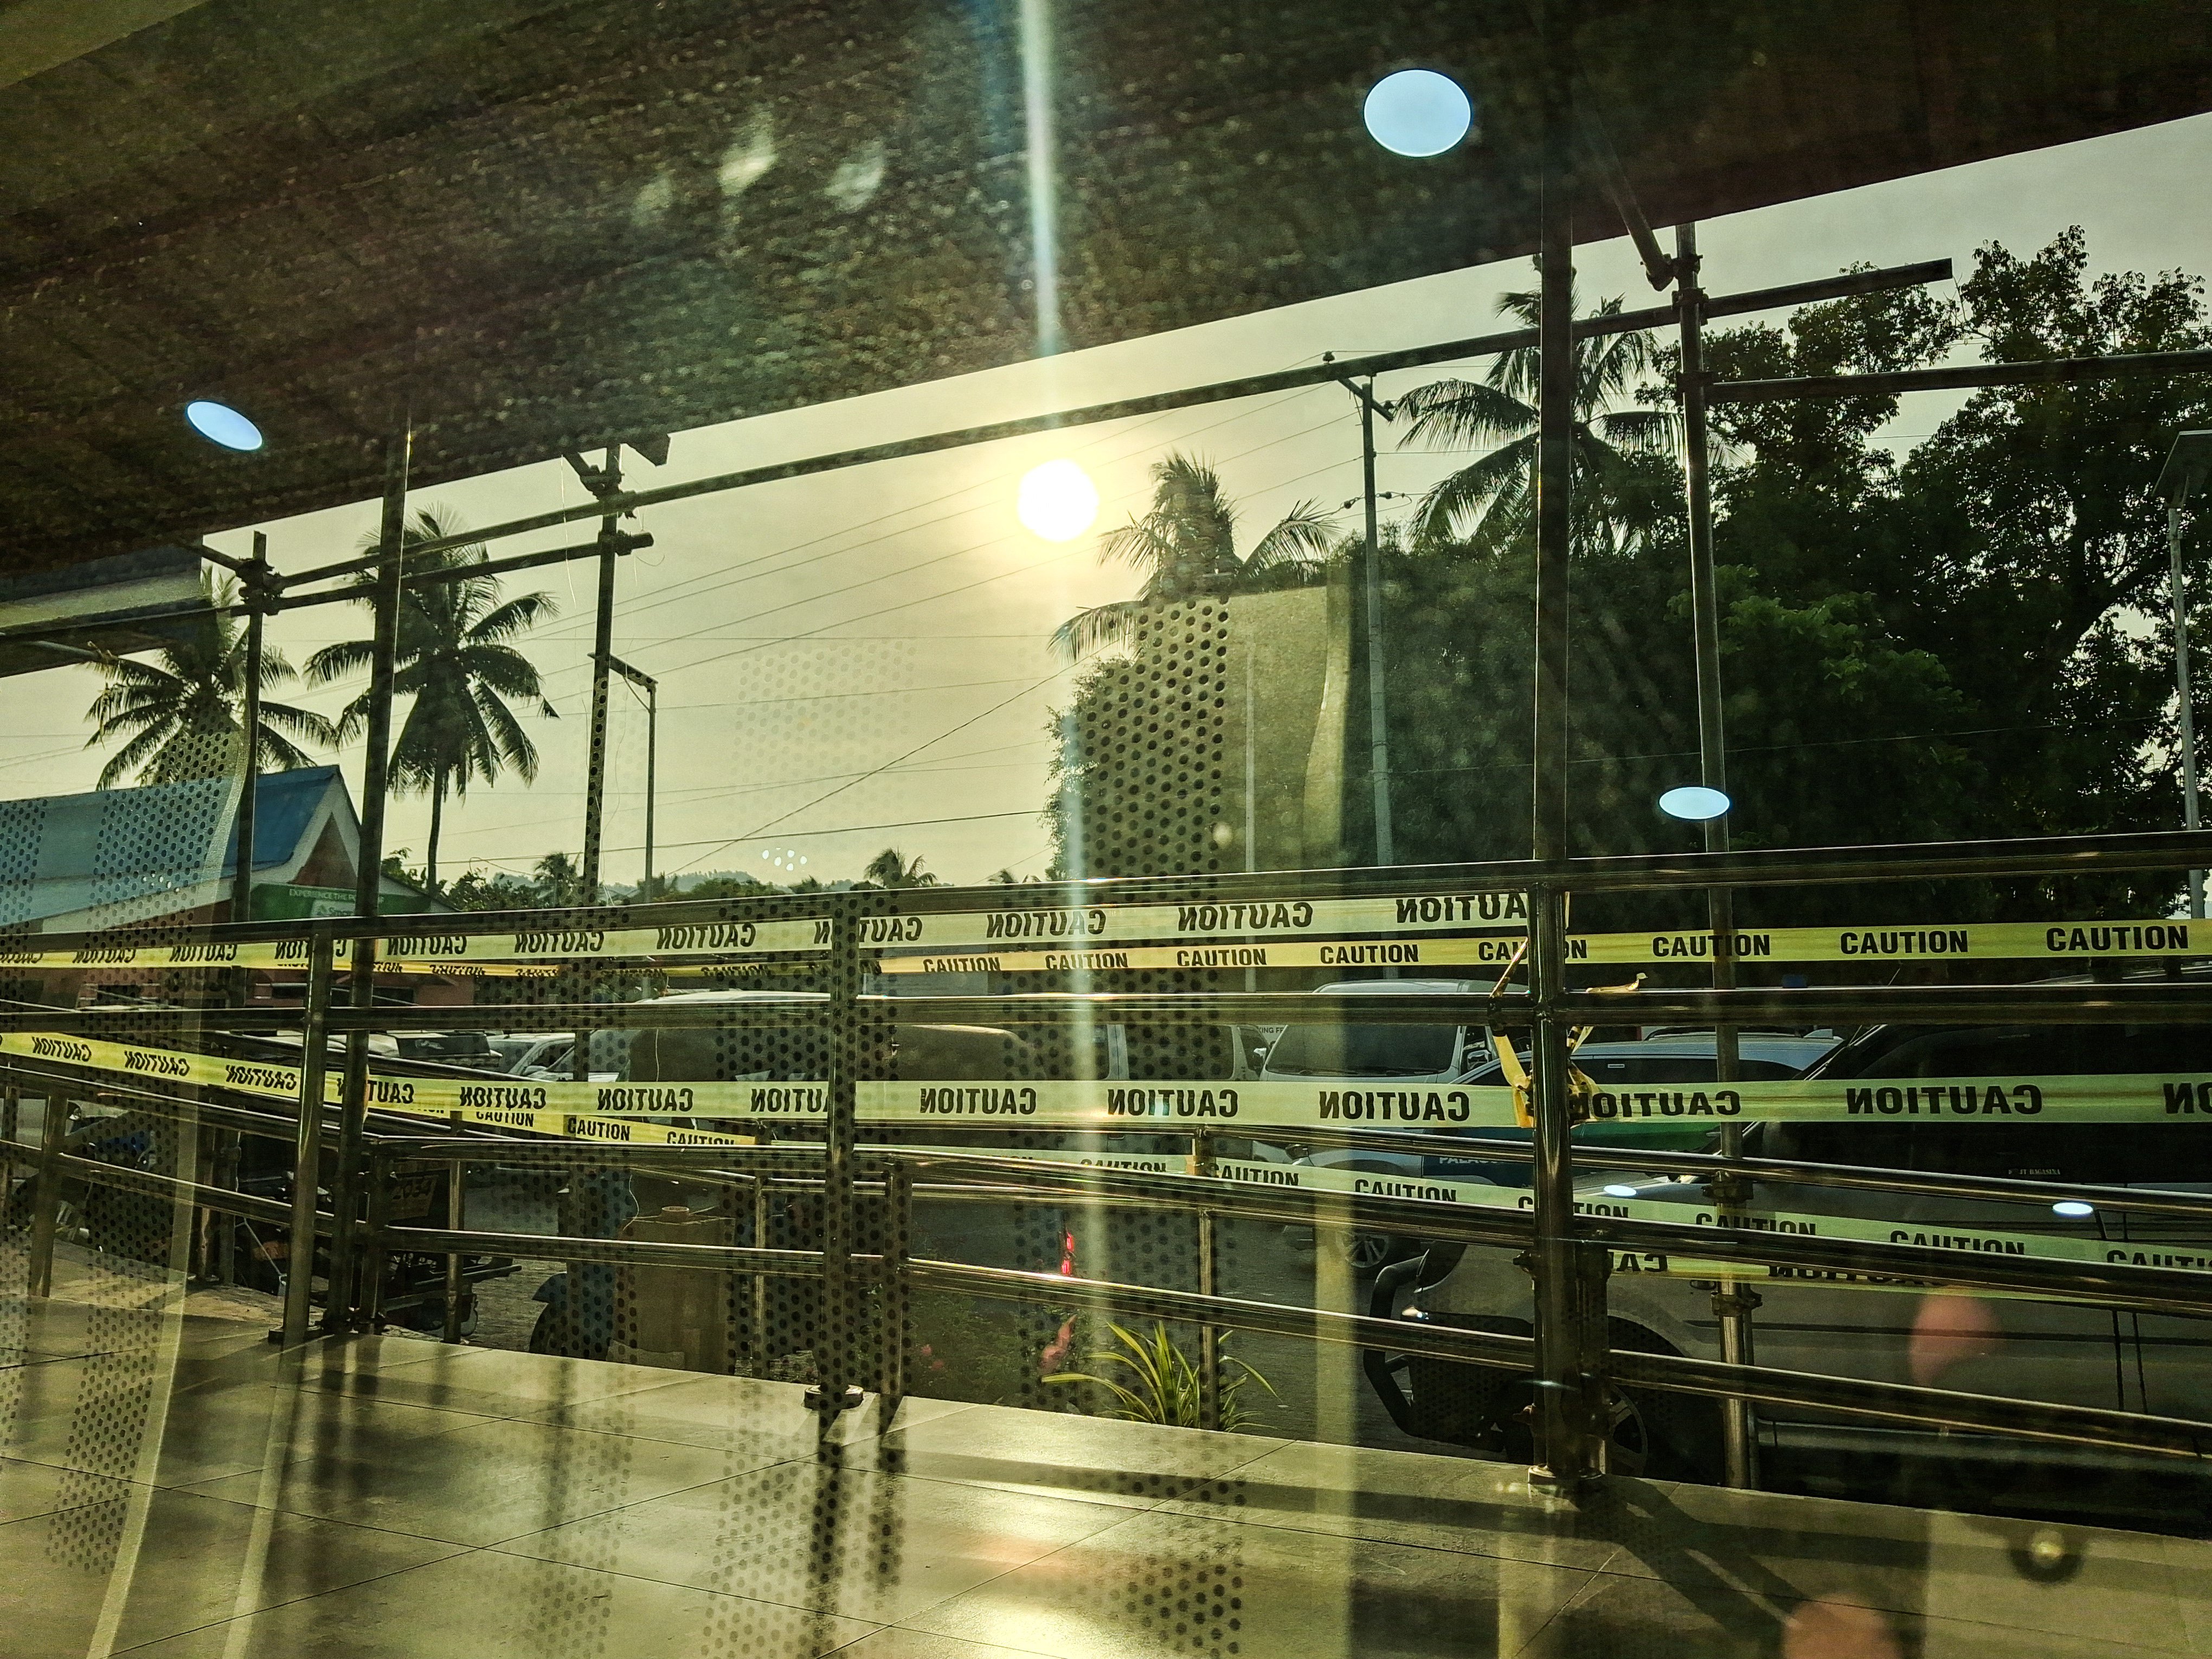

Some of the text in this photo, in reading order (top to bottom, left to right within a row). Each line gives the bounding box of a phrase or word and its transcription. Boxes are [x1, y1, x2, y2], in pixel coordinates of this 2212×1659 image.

[923, 956, 1001, 973] CAUTION
[1045, 953, 1128, 970] CAUTION
[1177, 949, 1266, 967] CAUTION
[1320, 944, 1419, 964] CAUTION
[1652, 934, 1770, 958] CAUTION
[1841, 930, 1969, 955] CAUTION
[2047, 925, 2189, 951] CAUTION
[569, 1117, 631, 1141] CAUTION
